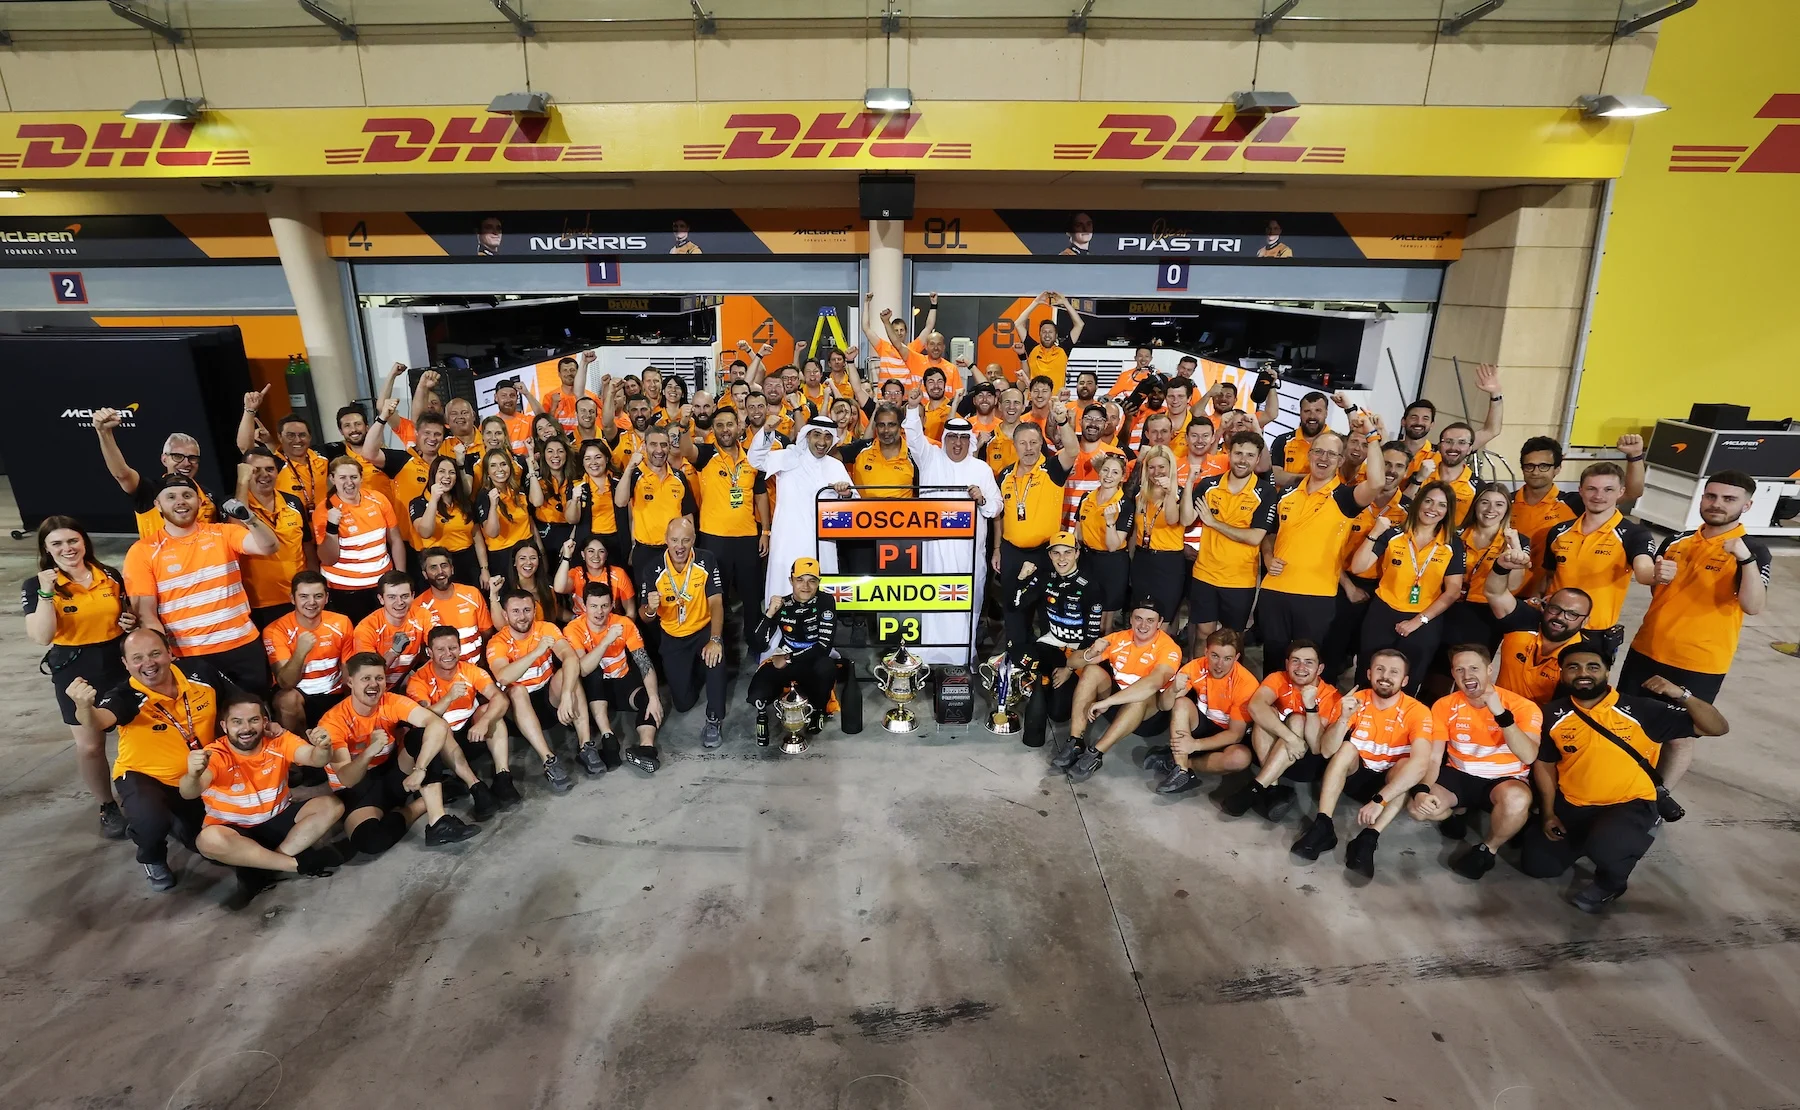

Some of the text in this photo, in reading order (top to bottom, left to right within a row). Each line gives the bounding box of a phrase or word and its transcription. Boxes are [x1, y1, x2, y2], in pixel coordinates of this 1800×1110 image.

[16, 122, 213, 168] DHL
[361, 117, 565, 162] DHL
[722, 112, 934, 159] DHL
[1092, 113, 1309, 163] DHL
[348, 220, 373, 252] 4
[792, 228, 847, 236] McLaren
[924, 217, 967, 249] 81
[1390, 234, 1444, 242] McLaren
[529, 236, 647, 251] NORRIS
[1117, 237, 1242, 252] PIASTRI
[599, 262, 607, 280] 1
[1166, 264, 1181, 285] 0
[61, 278, 78, 298] 2
[752, 316, 779, 352] 4
[855, 510, 939, 529] OSCAR
[878, 544, 919, 570] P1
[855, 584, 937, 602] LANDO
[879, 617, 920, 642] P3
[1048, 621, 1084, 640] OKX
